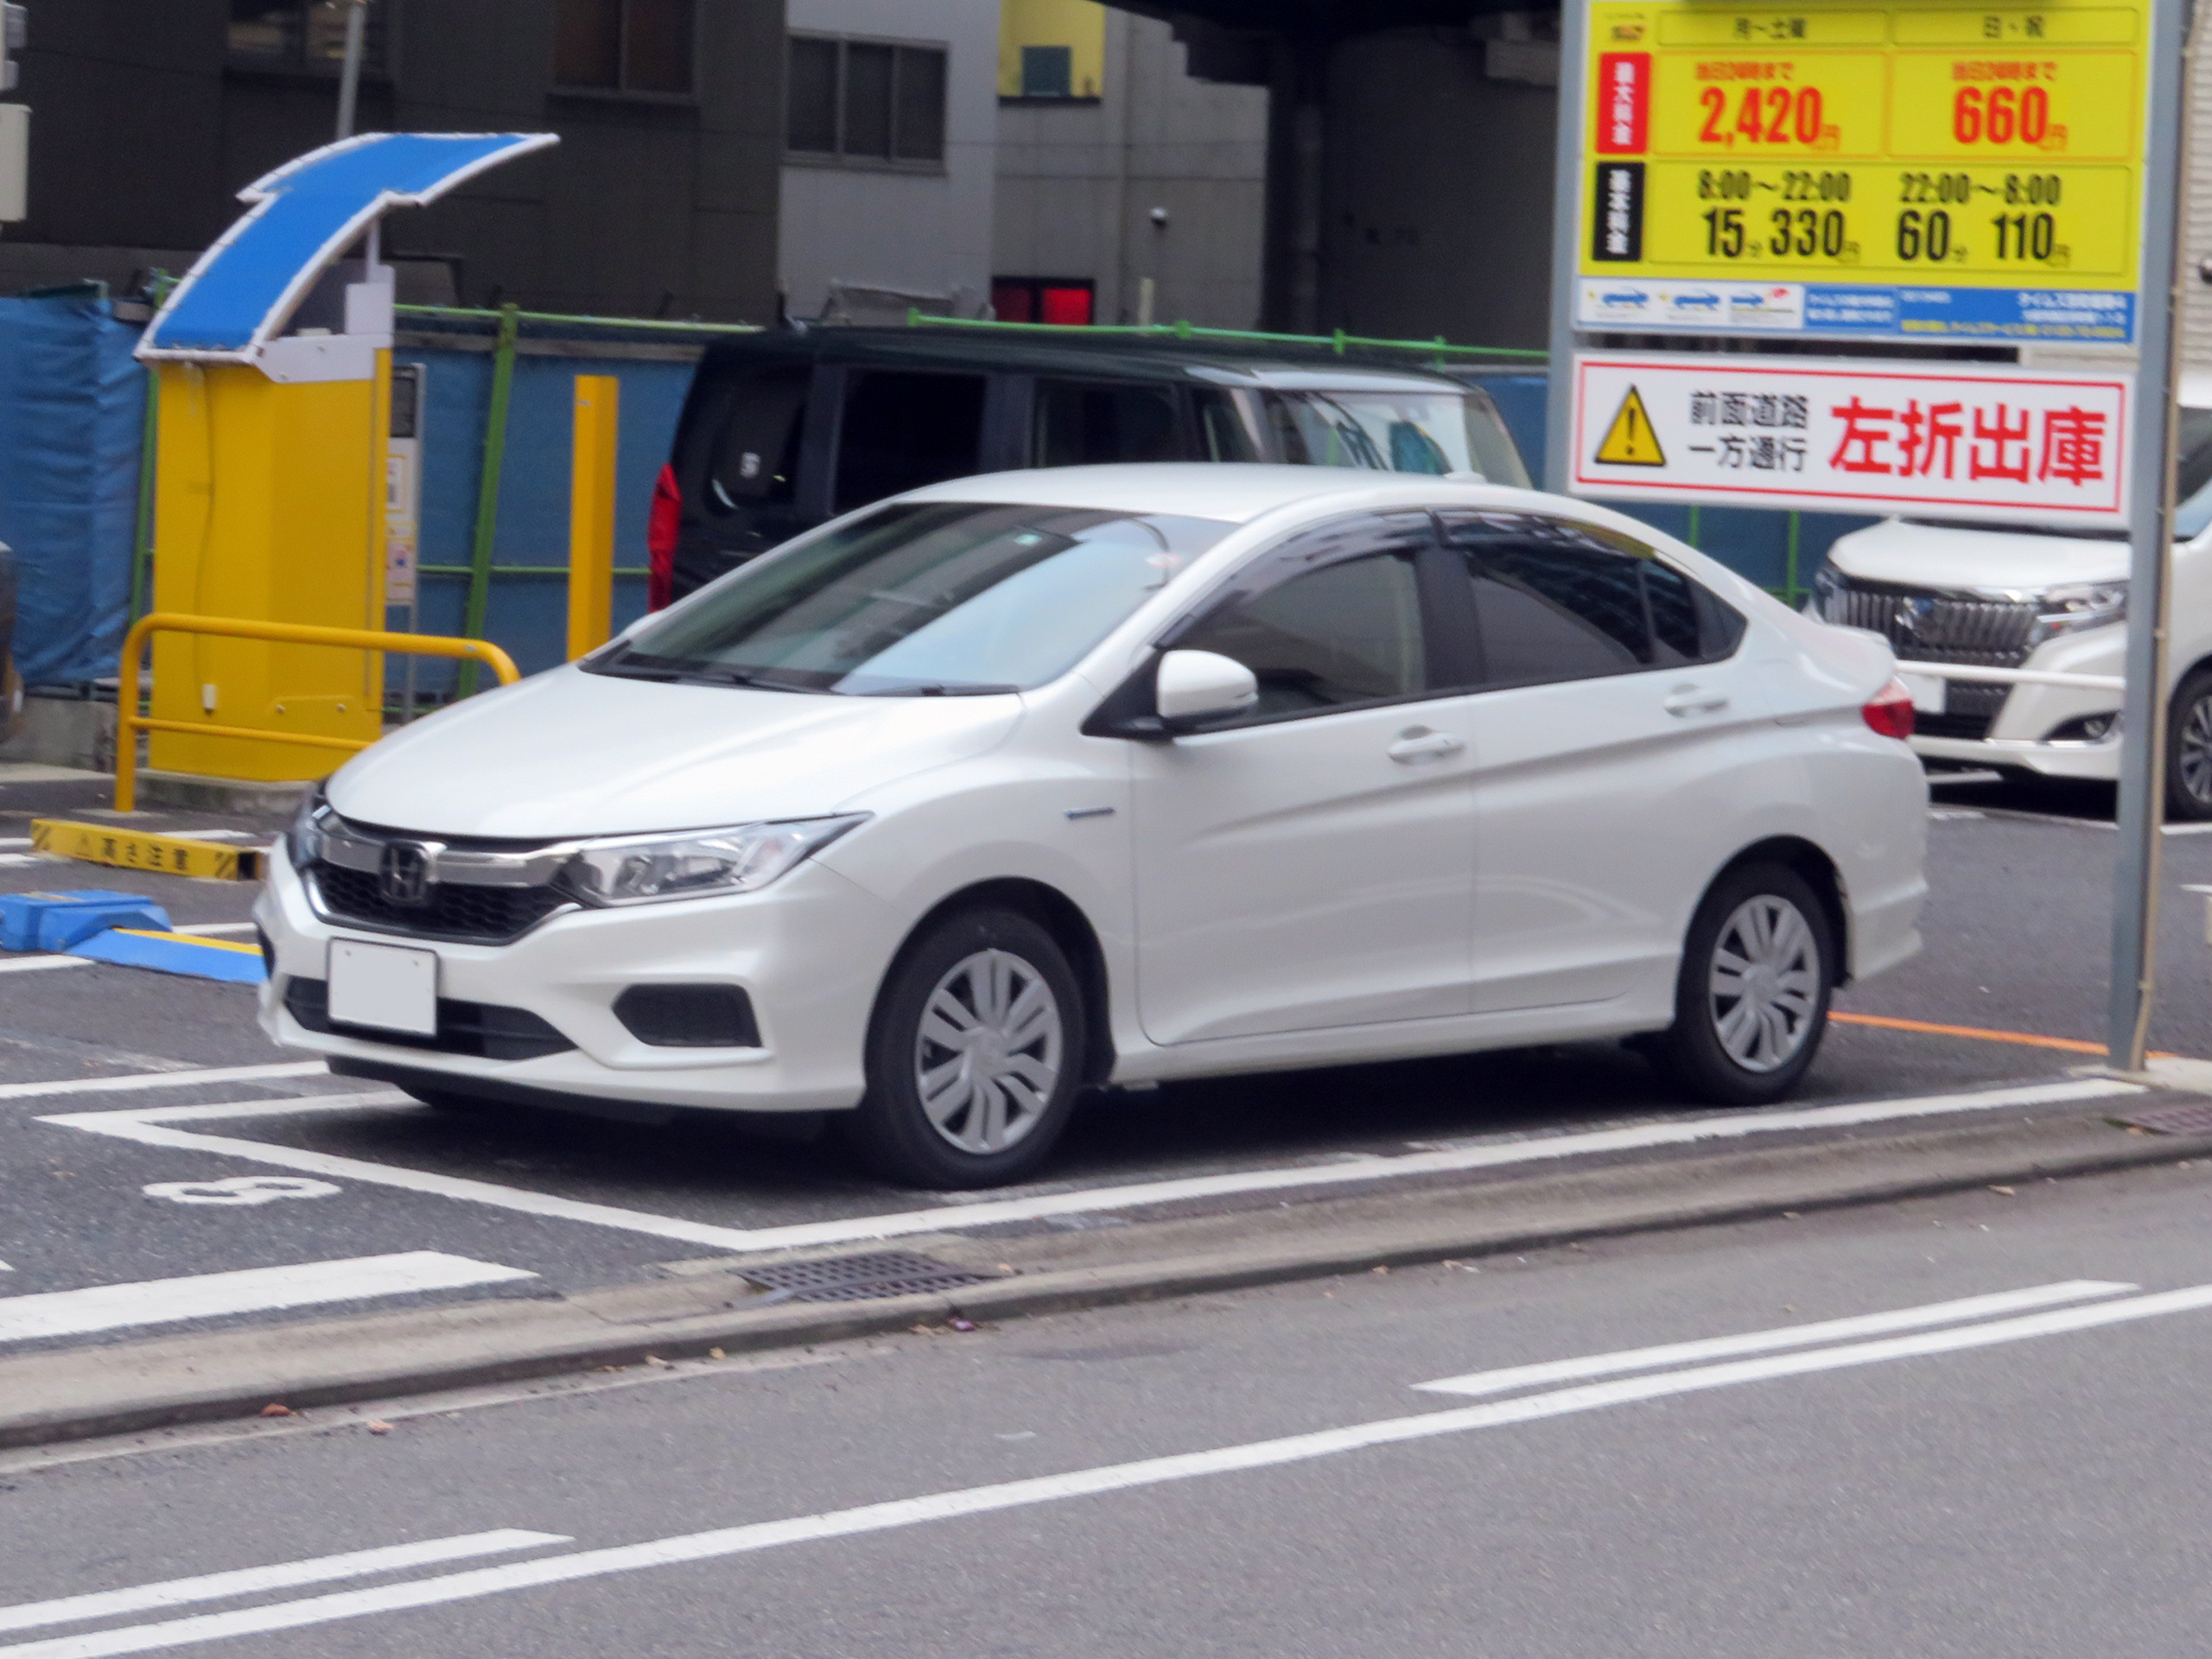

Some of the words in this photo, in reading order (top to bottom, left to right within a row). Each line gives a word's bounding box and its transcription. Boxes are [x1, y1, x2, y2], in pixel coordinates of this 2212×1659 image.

[1691, 391, 1808, 429] 前面道路
[1688, 435, 1808, 472] 一方通行
[1829, 396, 2106, 486] 左折出庫
